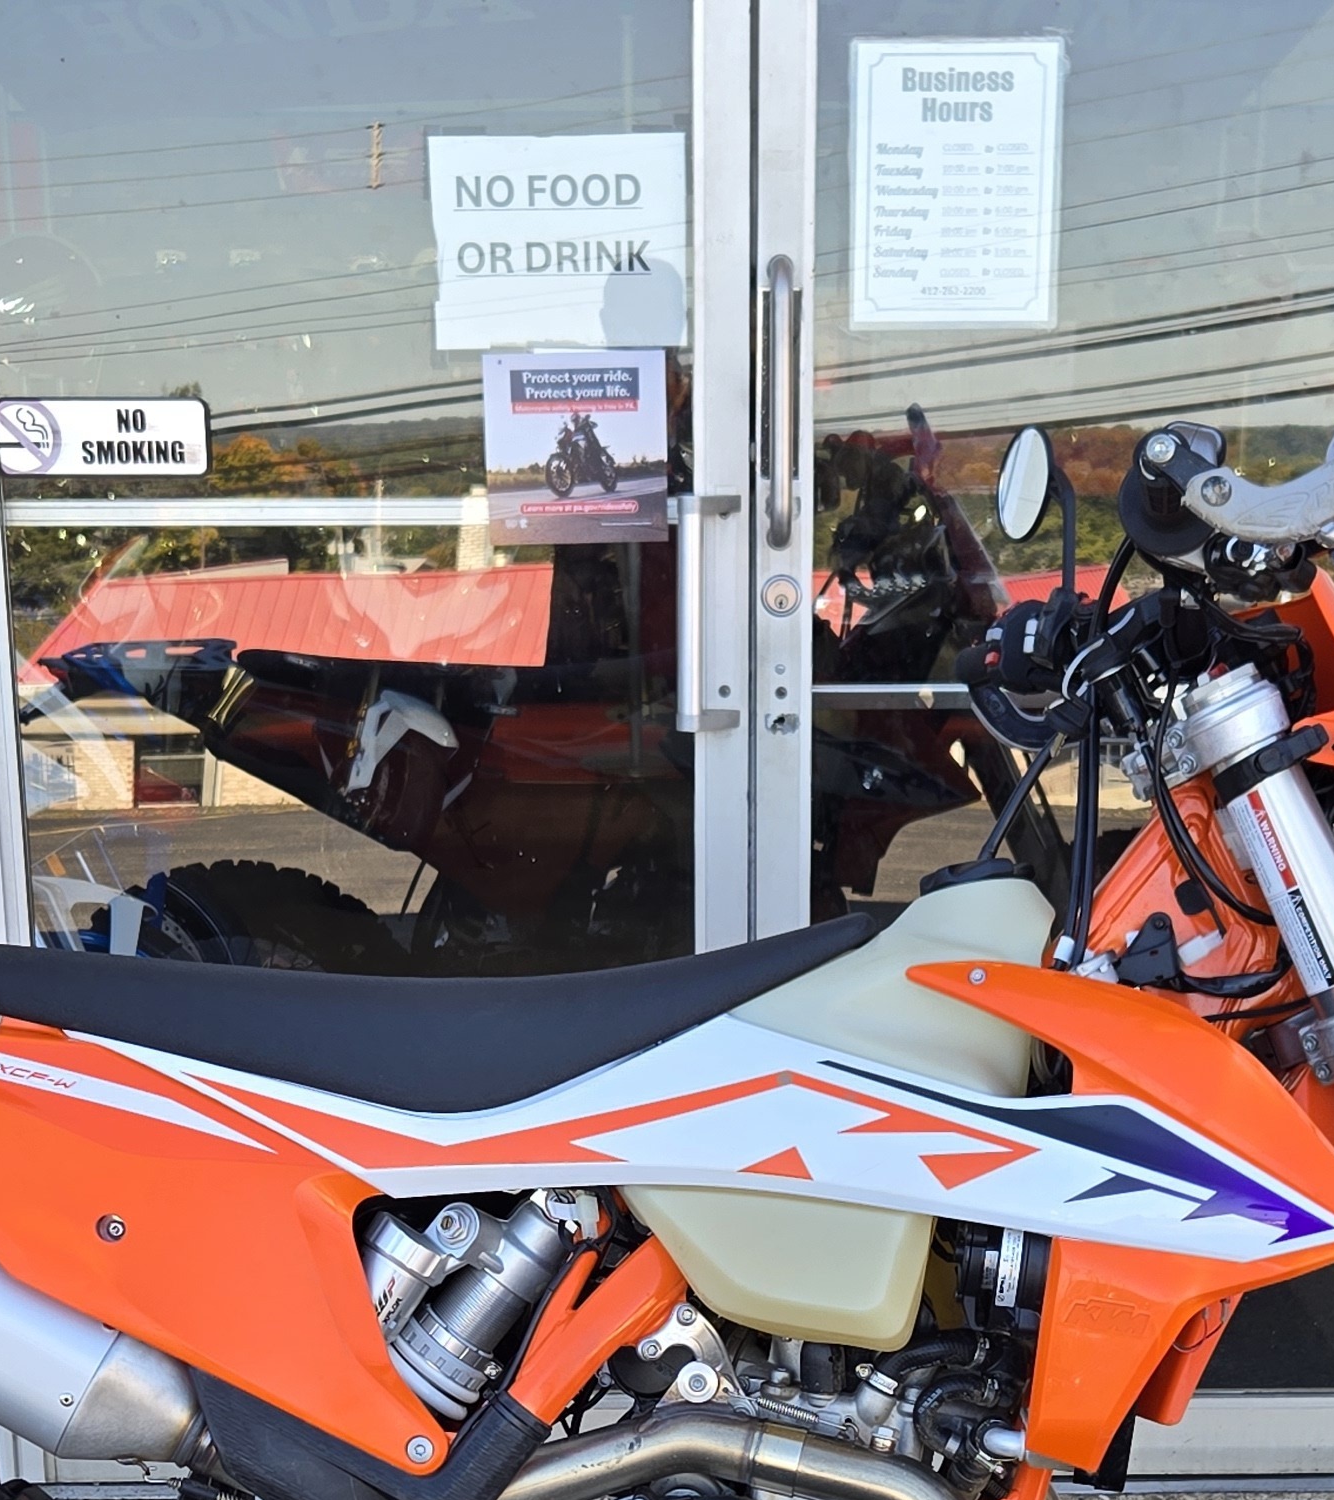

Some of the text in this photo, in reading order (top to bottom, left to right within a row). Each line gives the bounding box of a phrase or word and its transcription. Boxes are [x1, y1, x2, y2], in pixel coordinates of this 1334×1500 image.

[901, 67, 1015, 92] Business
[921, 97, 993, 122] Hours
[876, 143, 924, 158] Monday
[874, 164, 924, 180] Tuesday
[455, 173, 642, 208] NO FOOD
[874, 185, 939, 199] Wednesday
[873, 205, 930, 221] Thursday
[873, 225, 913, 240] Friday
[457, 239, 652, 274] OR DRINK
[873, 245, 929, 260] Saturday
[872, 265, 919, 281] Sunday
[522, 370, 633, 386] Protect your ride.
[525, 385, 631, 401] Protect your life.
[116, 408, 147, 433] NO
[82, 440, 186, 465] SMOKING
[523, 505, 543, 513] Learn
[545, 505, 563, 513] more
[1259, 821, 1286, 873] WARNING
[1295, 906, 1333, 980] COMPETITION ONLY
[1062, 1298, 1151, 1340] KTM
